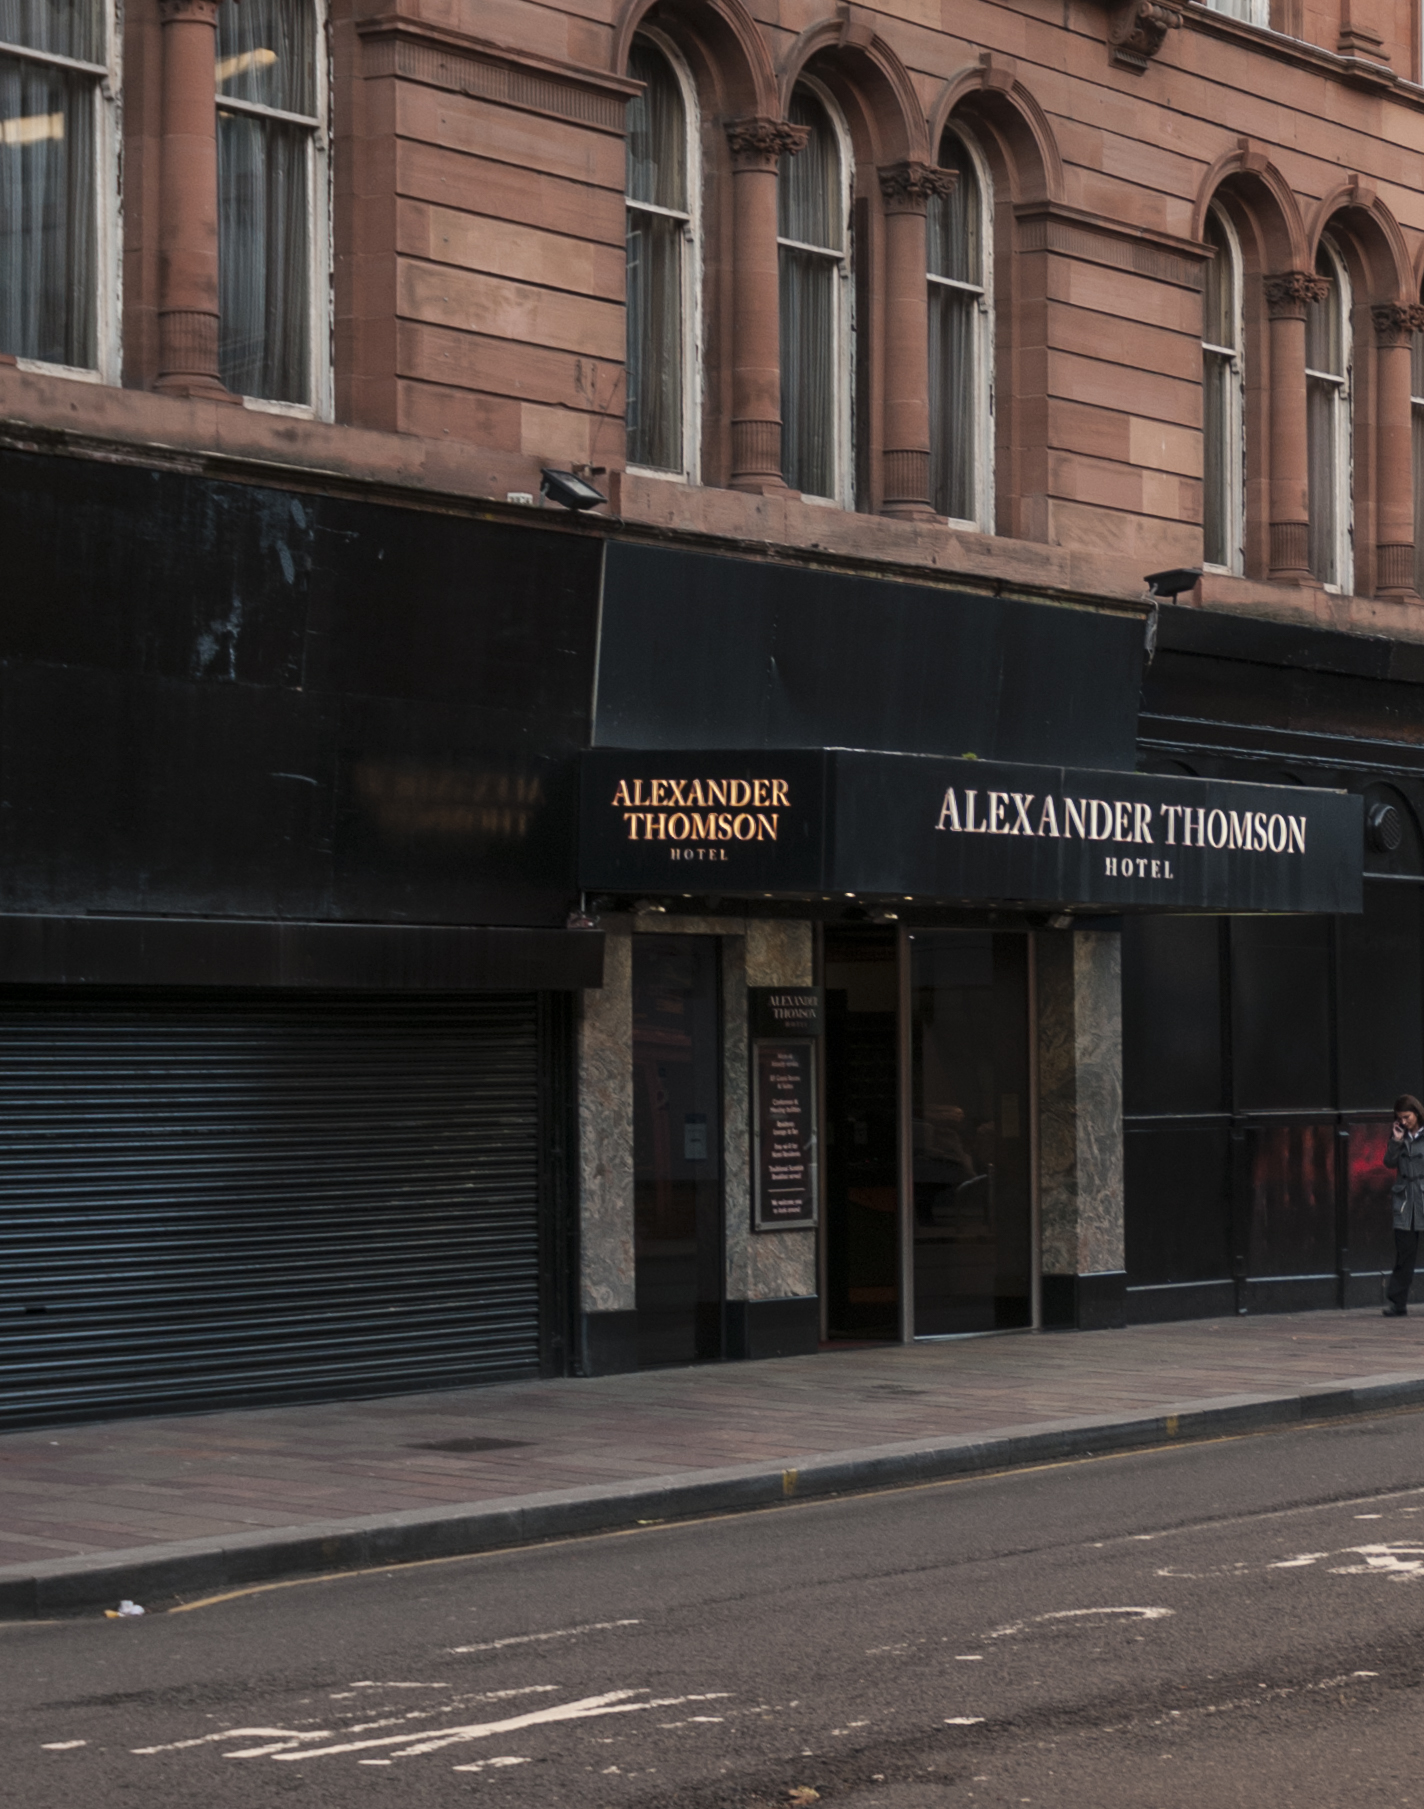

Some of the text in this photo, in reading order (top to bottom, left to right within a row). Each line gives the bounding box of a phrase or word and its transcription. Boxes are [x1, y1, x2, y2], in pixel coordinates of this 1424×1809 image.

[611, 778, 791, 810] ALEXANDER
[624, 812, 780, 841] THOMSON
[935, 786, 1308, 855] ALEXANDER THOMSON
[670, 847, 729, 862] HOTEL
[1104, 856, 1175, 880] HOTEL
